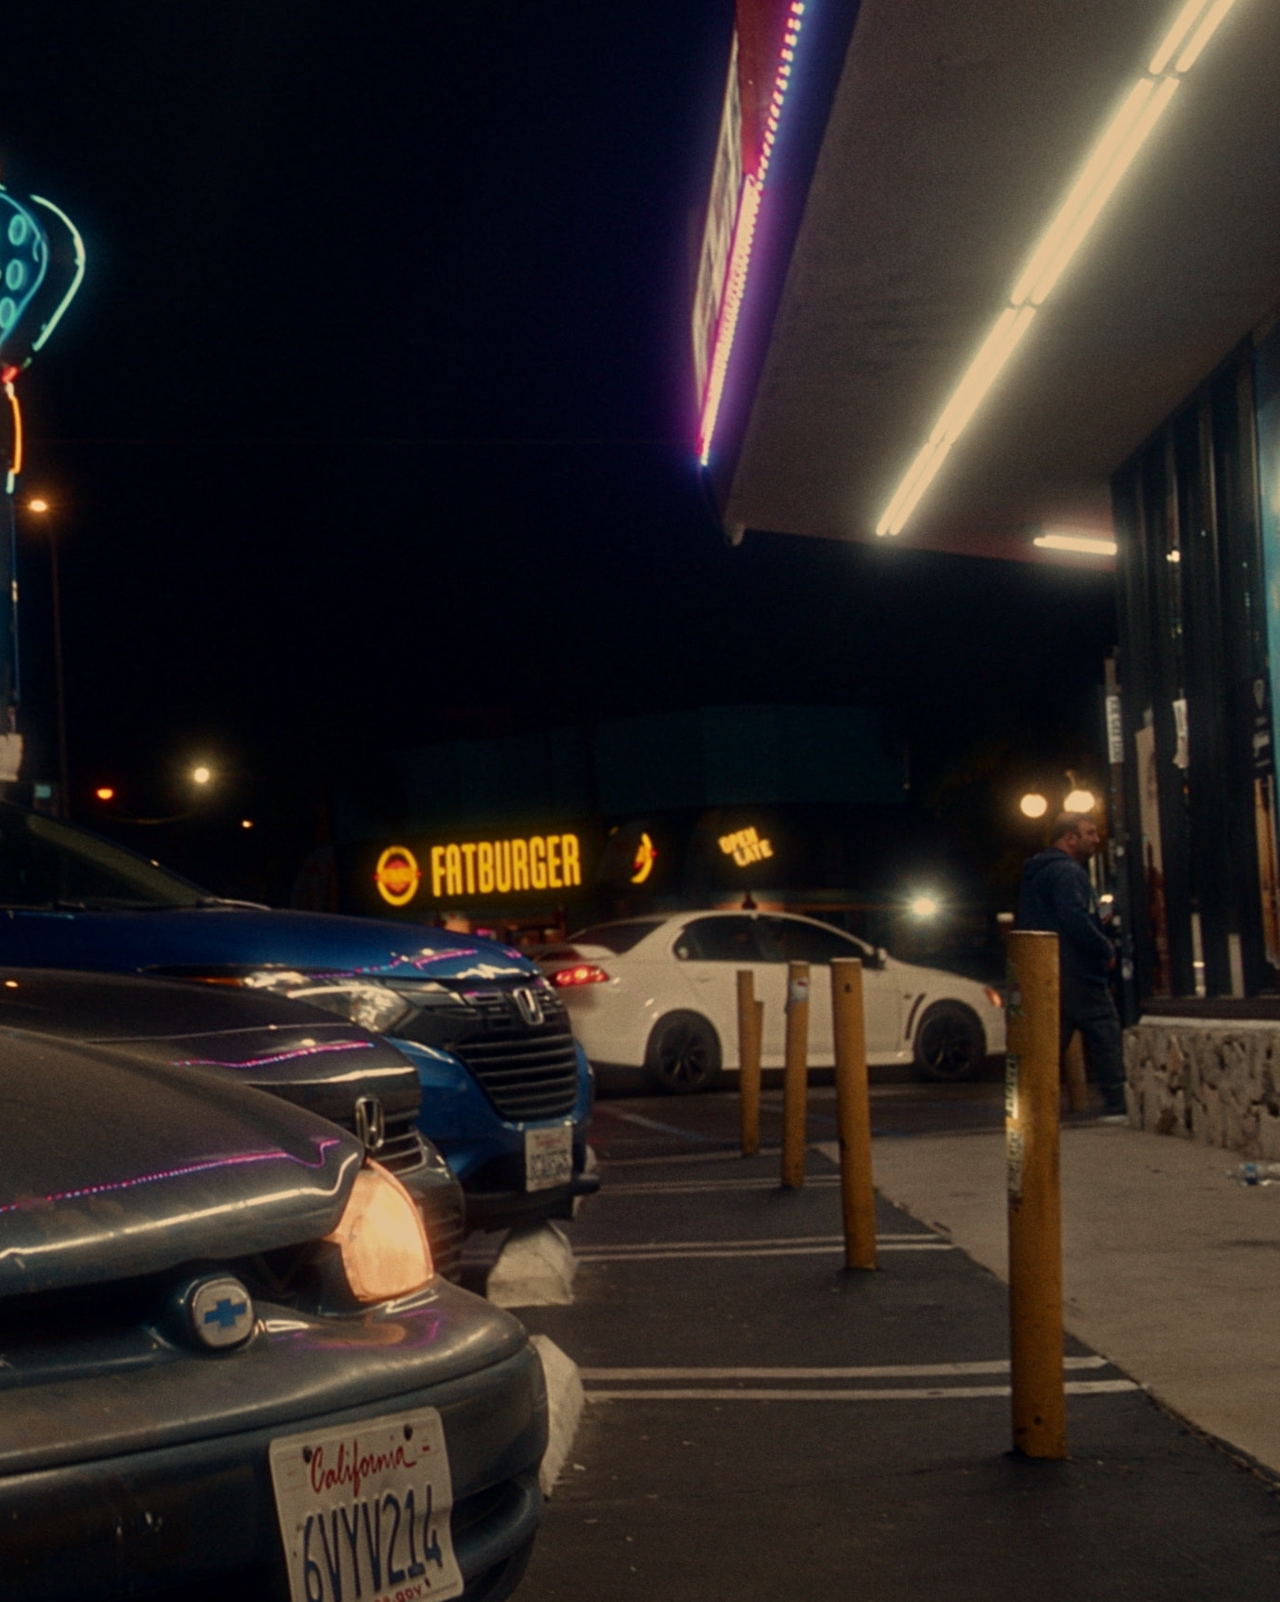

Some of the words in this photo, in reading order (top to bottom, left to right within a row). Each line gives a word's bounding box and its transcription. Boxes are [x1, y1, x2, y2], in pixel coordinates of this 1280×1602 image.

[431, 833, 581, 898] FATBURGER
[719, 826, 758, 854] OPEN
[733, 839, 773, 867] LATE
[310, 1439, 417, 1498] California
[303, 1483, 443, 1602] 6VYV214
